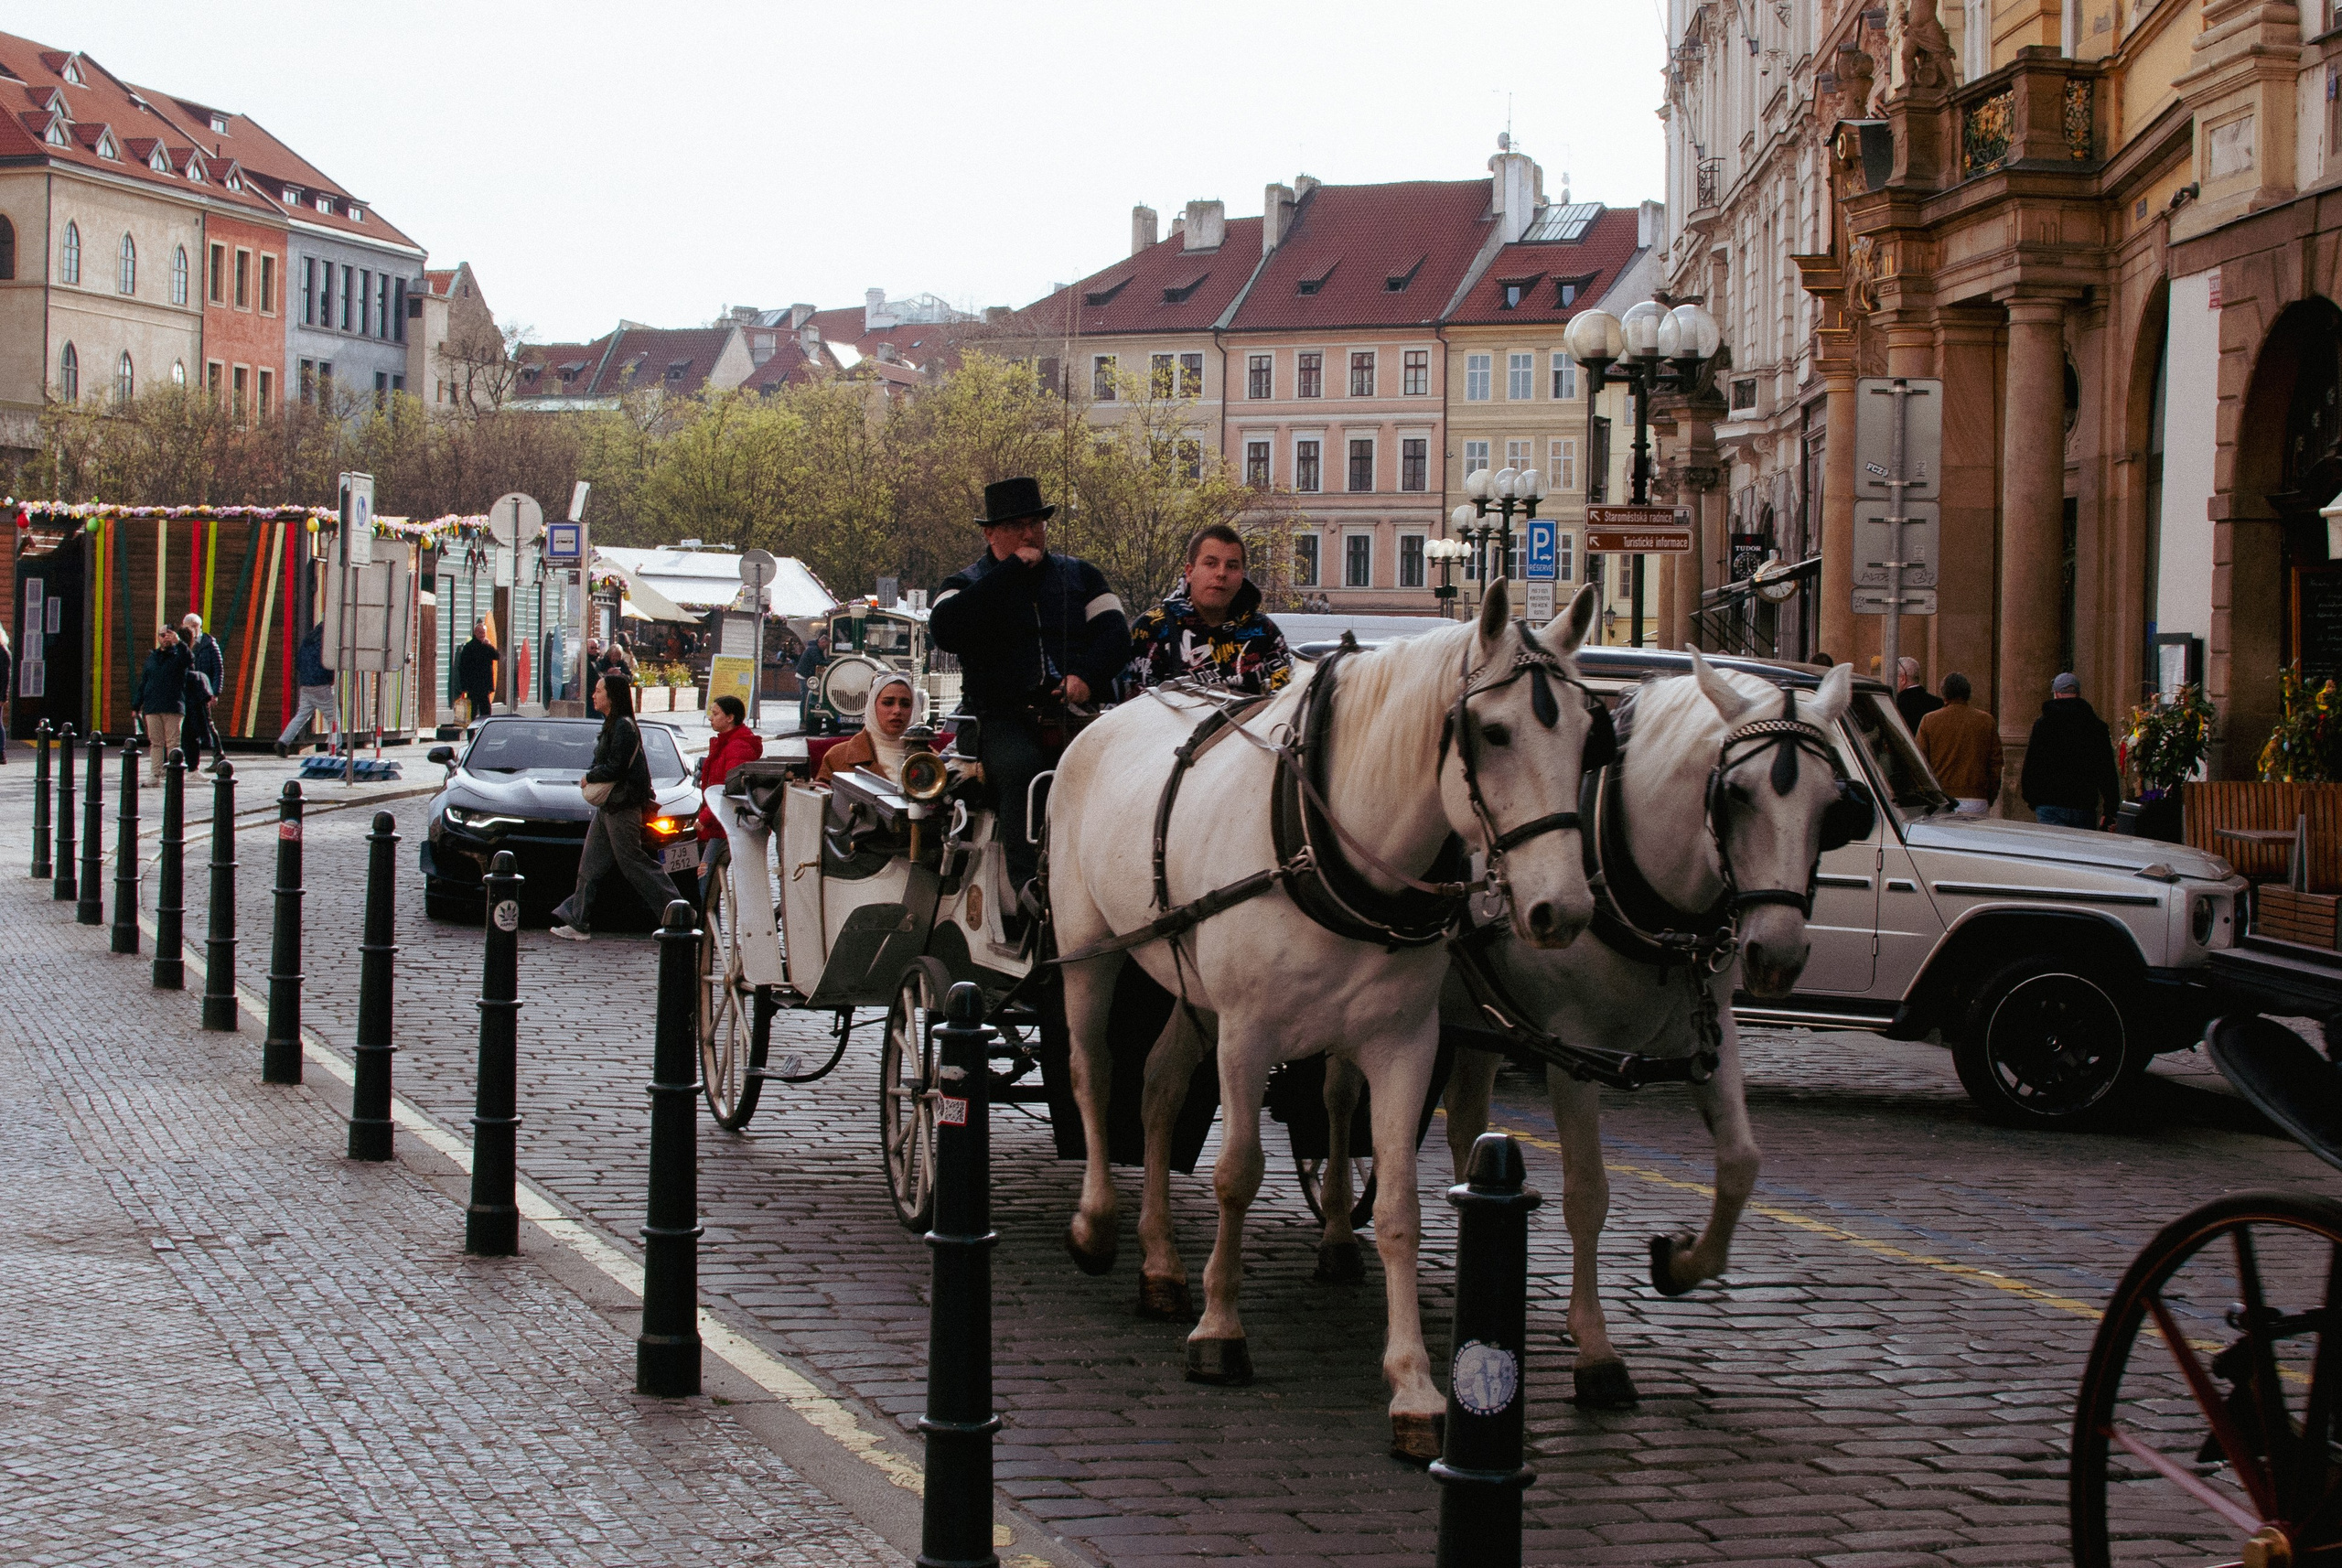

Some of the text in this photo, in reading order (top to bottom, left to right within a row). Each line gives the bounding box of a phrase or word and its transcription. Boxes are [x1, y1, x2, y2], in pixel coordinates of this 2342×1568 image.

[1604, 510, 1672, 523] Staroměstská radnice
[1532, 527, 1551, 560] P
[1623, 535, 1688, 548] Turistické informace
[1529, 564, 1552, 572] RÉSERVÉ
